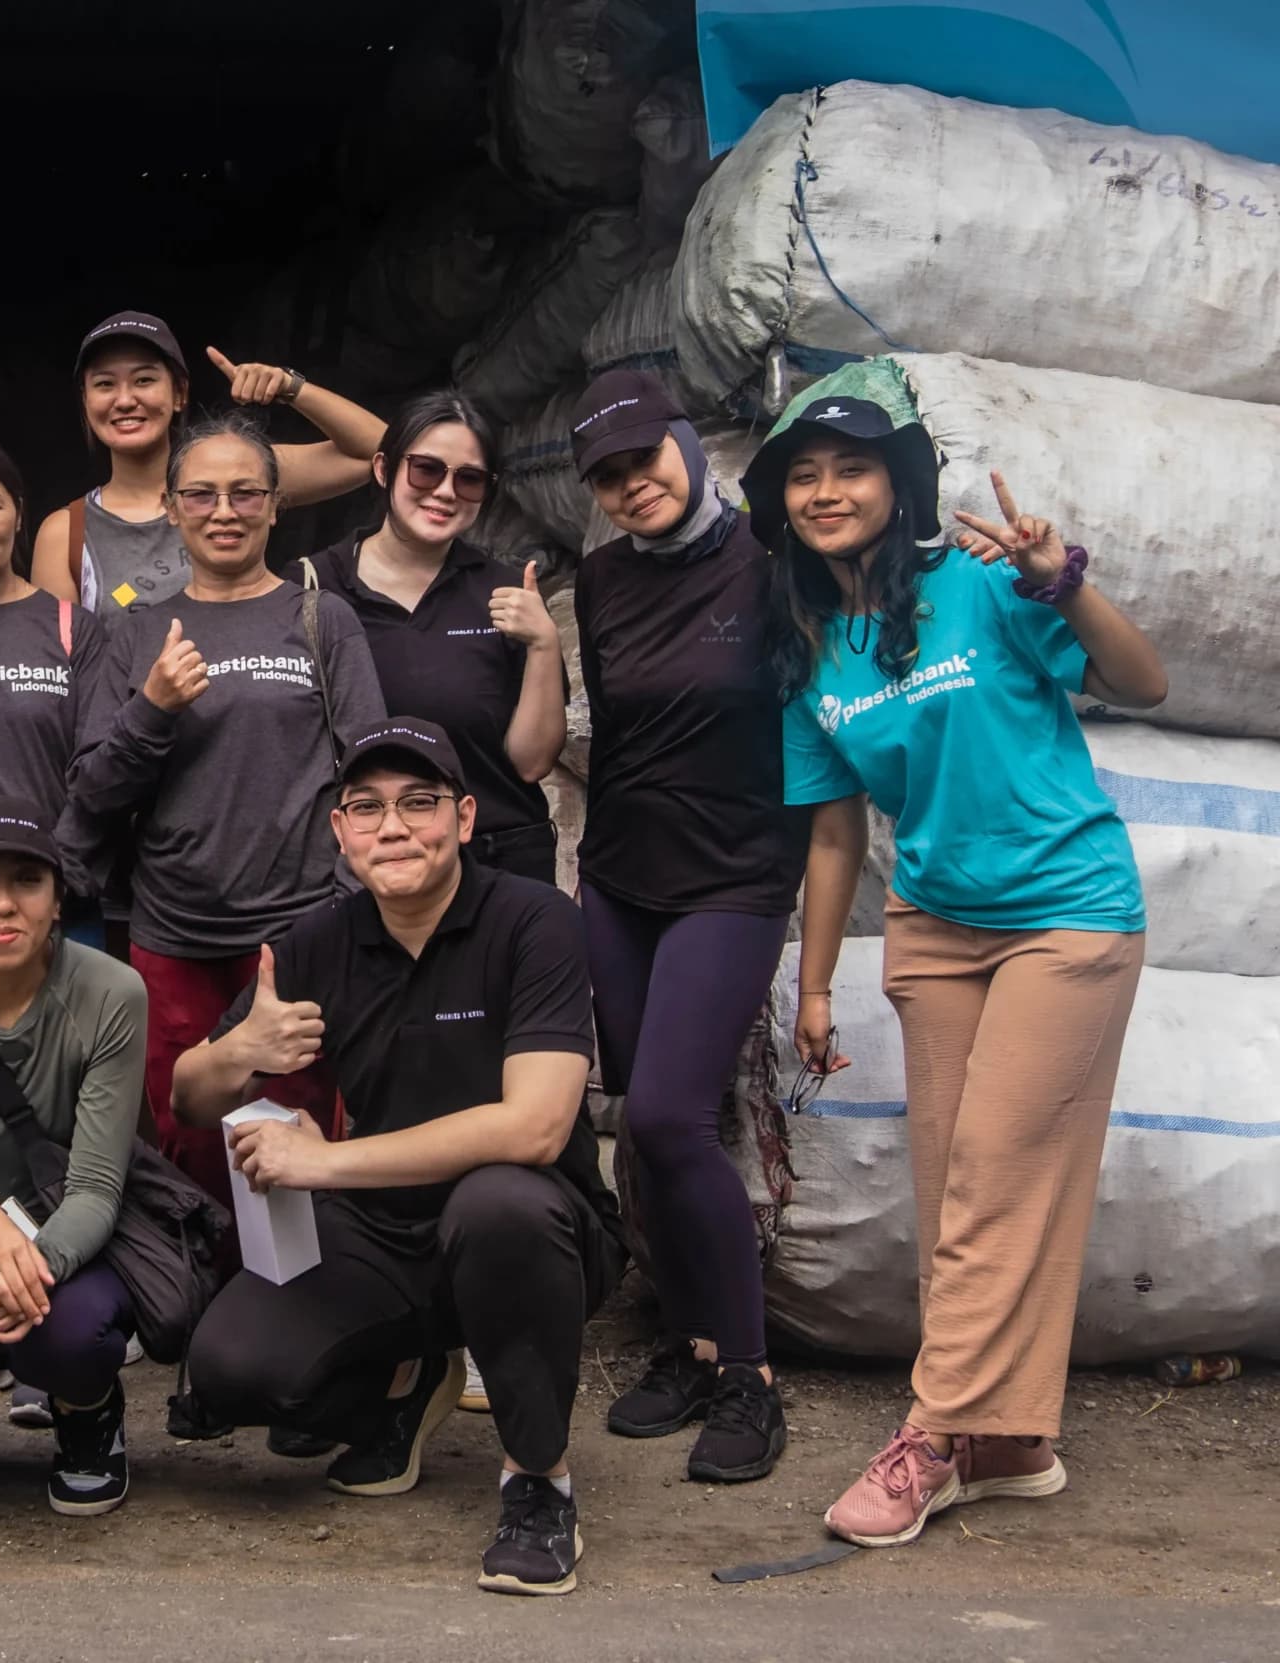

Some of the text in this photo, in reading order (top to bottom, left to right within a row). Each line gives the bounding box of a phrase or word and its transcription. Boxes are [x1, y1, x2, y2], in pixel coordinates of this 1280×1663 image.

[207, 655, 313, 677] asticbank
[252, 671, 313, 688] Indonesia
[11, 682, 70, 698] Indonesia
[906, 675, 976, 705] Indonesia
